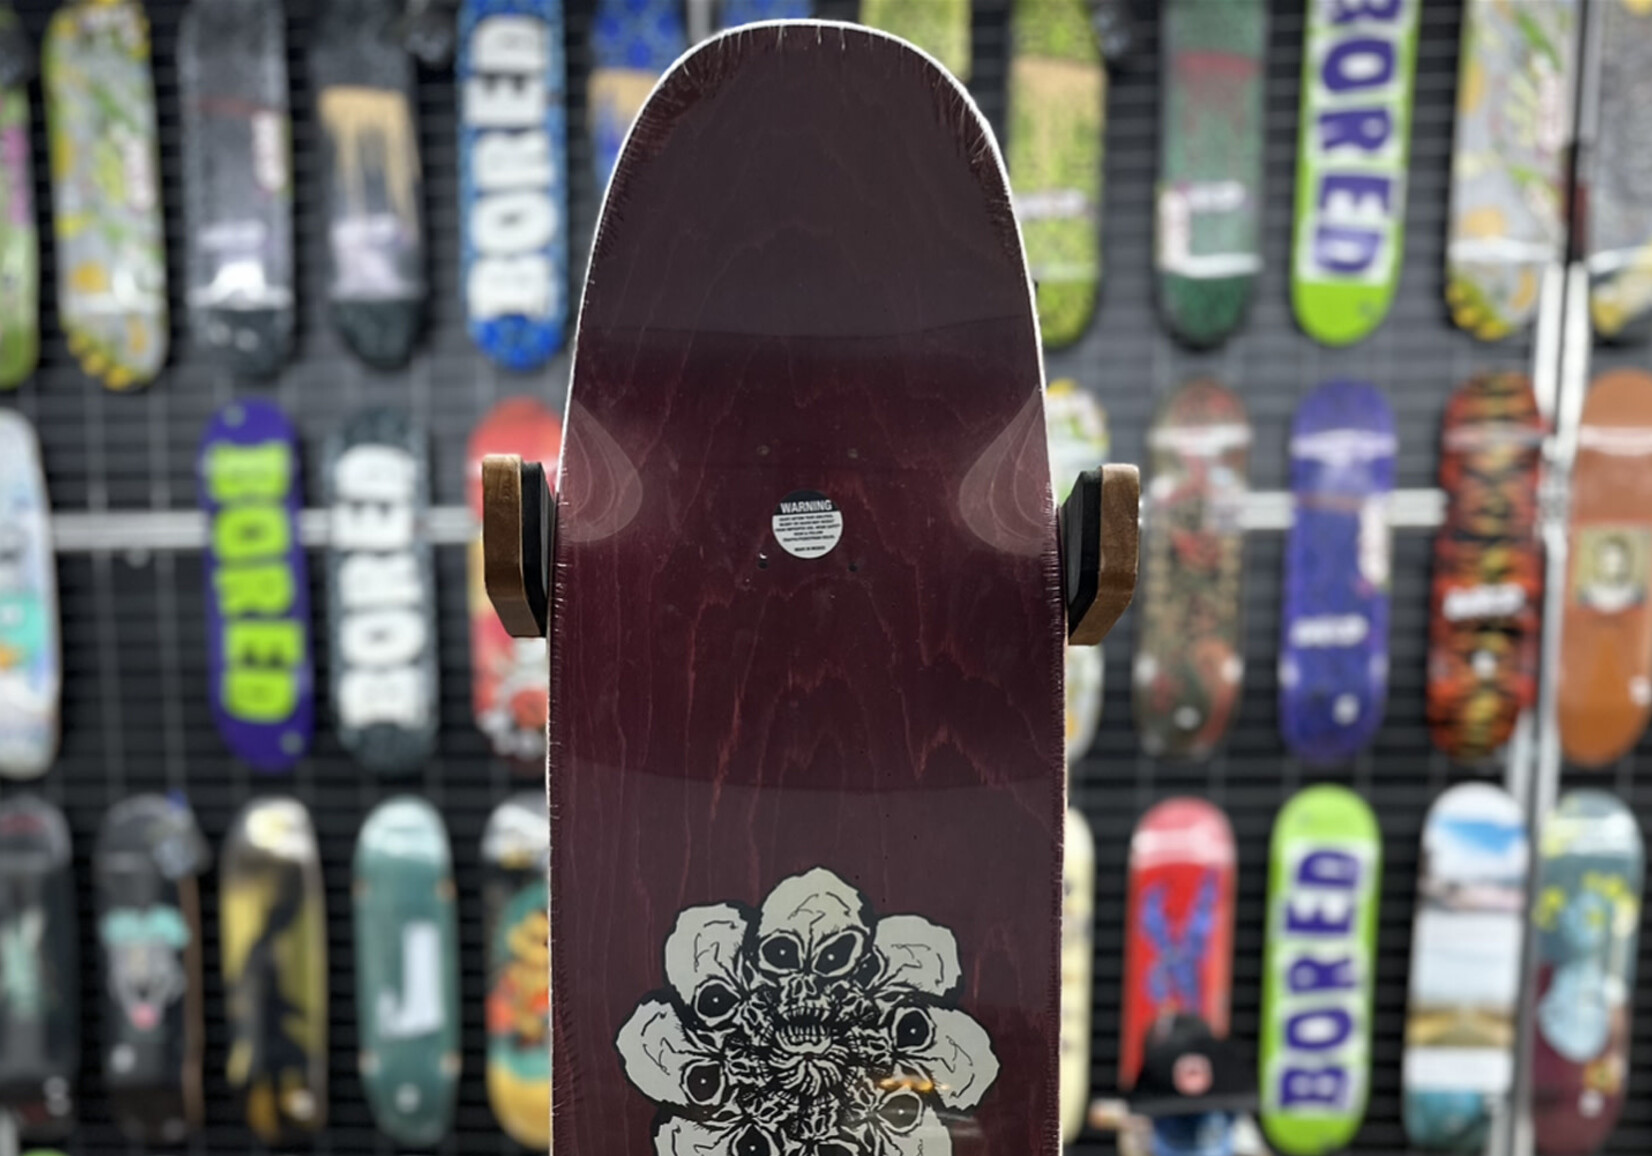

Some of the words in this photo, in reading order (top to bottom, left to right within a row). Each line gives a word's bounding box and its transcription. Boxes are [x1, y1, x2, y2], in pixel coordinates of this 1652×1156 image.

[466, 14, 558, 320] BORED
[205, 442, 304, 722] BORED
[330, 443, 428, 728] BORED
[780, 499, 832, 514] WARNING
[1279, 847, 1362, 1110] BORED
